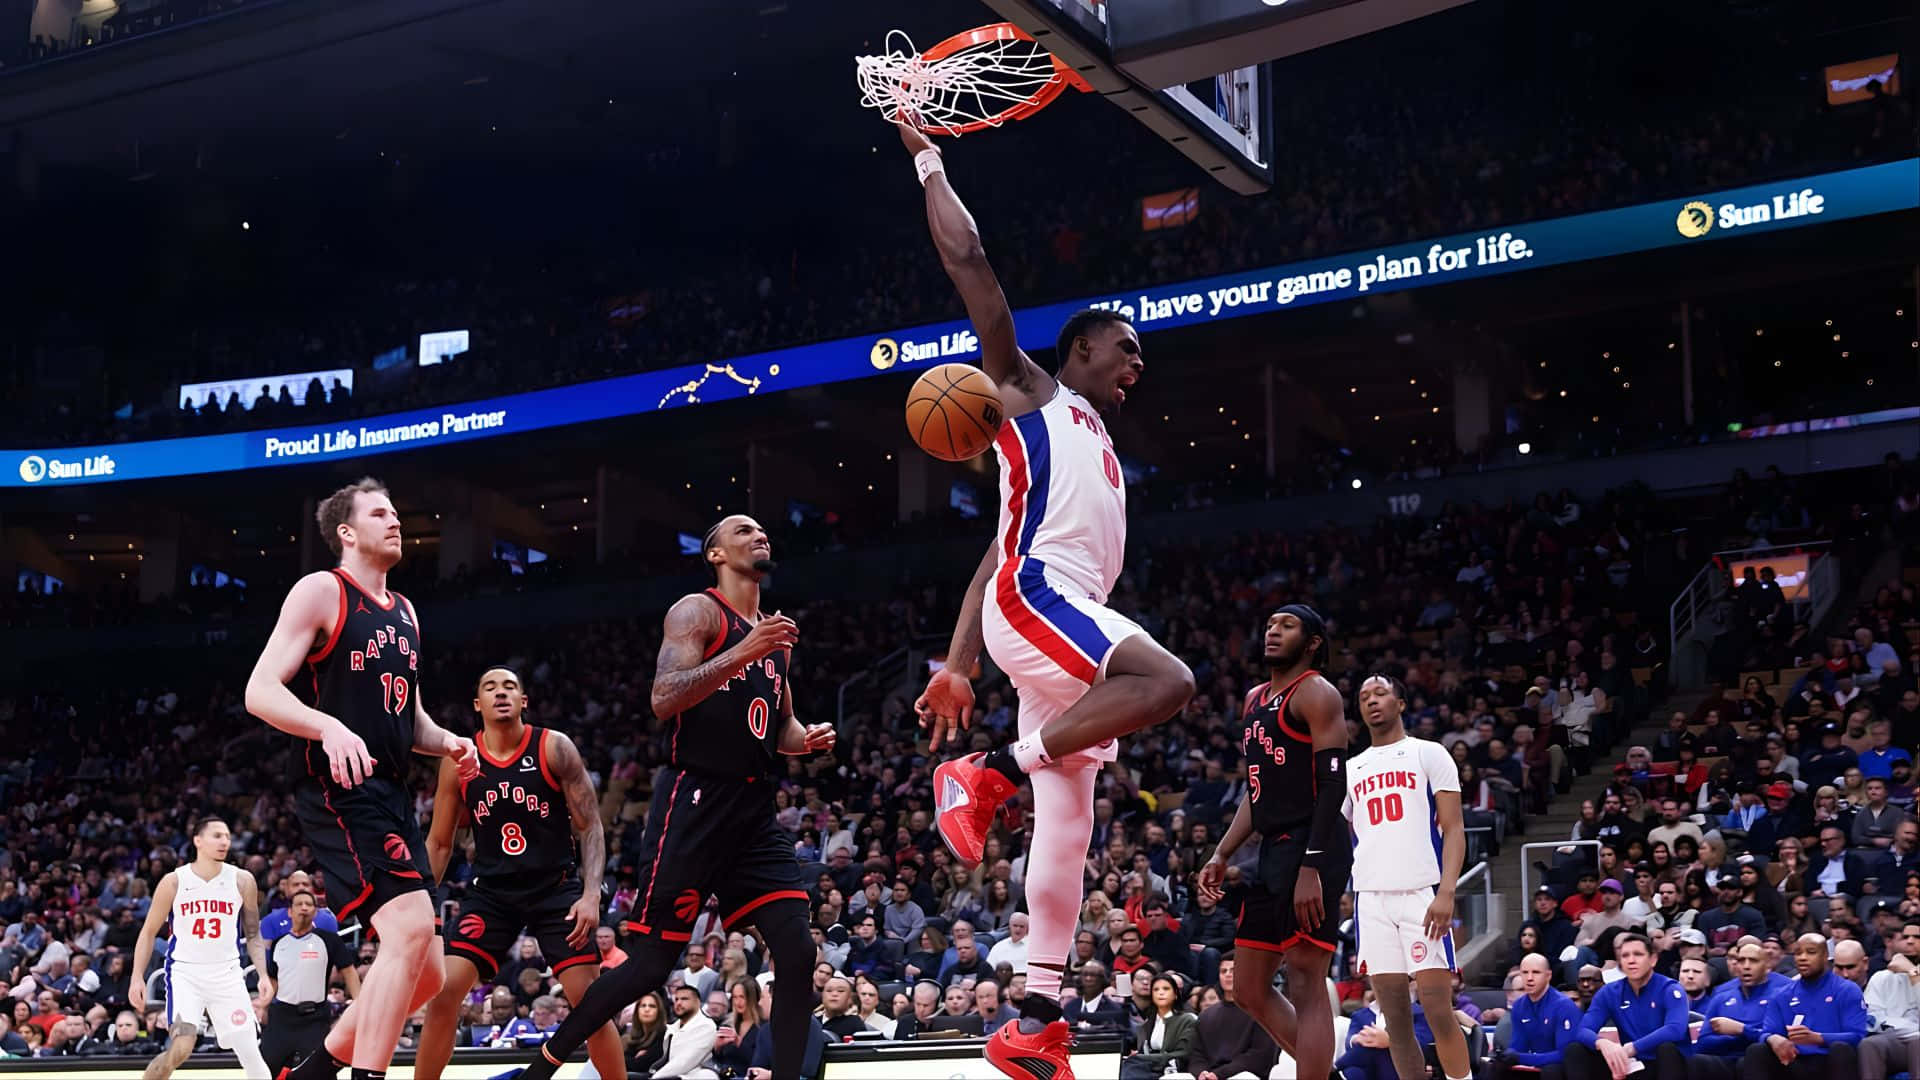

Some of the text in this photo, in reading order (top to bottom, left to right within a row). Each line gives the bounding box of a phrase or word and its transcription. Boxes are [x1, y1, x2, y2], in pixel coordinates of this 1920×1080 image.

[1718, 188, 1825, 229] Sun Life
[1139, 294, 1204, 321] have
[1207, 281, 1273, 316] your
[1276, 268, 1352, 305] game
[1358, 254, 1423, 292] plan
[1426, 244, 1472, 274] for
[1476, 232, 1534, 266] life.
[900, 330, 978, 364] Sun Life
[265, 410, 506, 458] Proud Life Insurance Partner
[48, 454, 116, 479] Sun Life
[1102, 448, 1119, 489] 0
[351, 625, 418, 671] RAPTOR
[380, 672, 409, 716] 19
[748, 697, 769, 739] 0
[474, 781, 550, 825] APTORS
[1249, 764, 1261, 804] 5
[1353, 770, 1417, 802] PISTONS
[1367, 793, 1404, 826] 00
[501, 822, 527, 856] 8
[180, 899, 234, 917] PISTONS
[192, 917, 222, 940] 43
